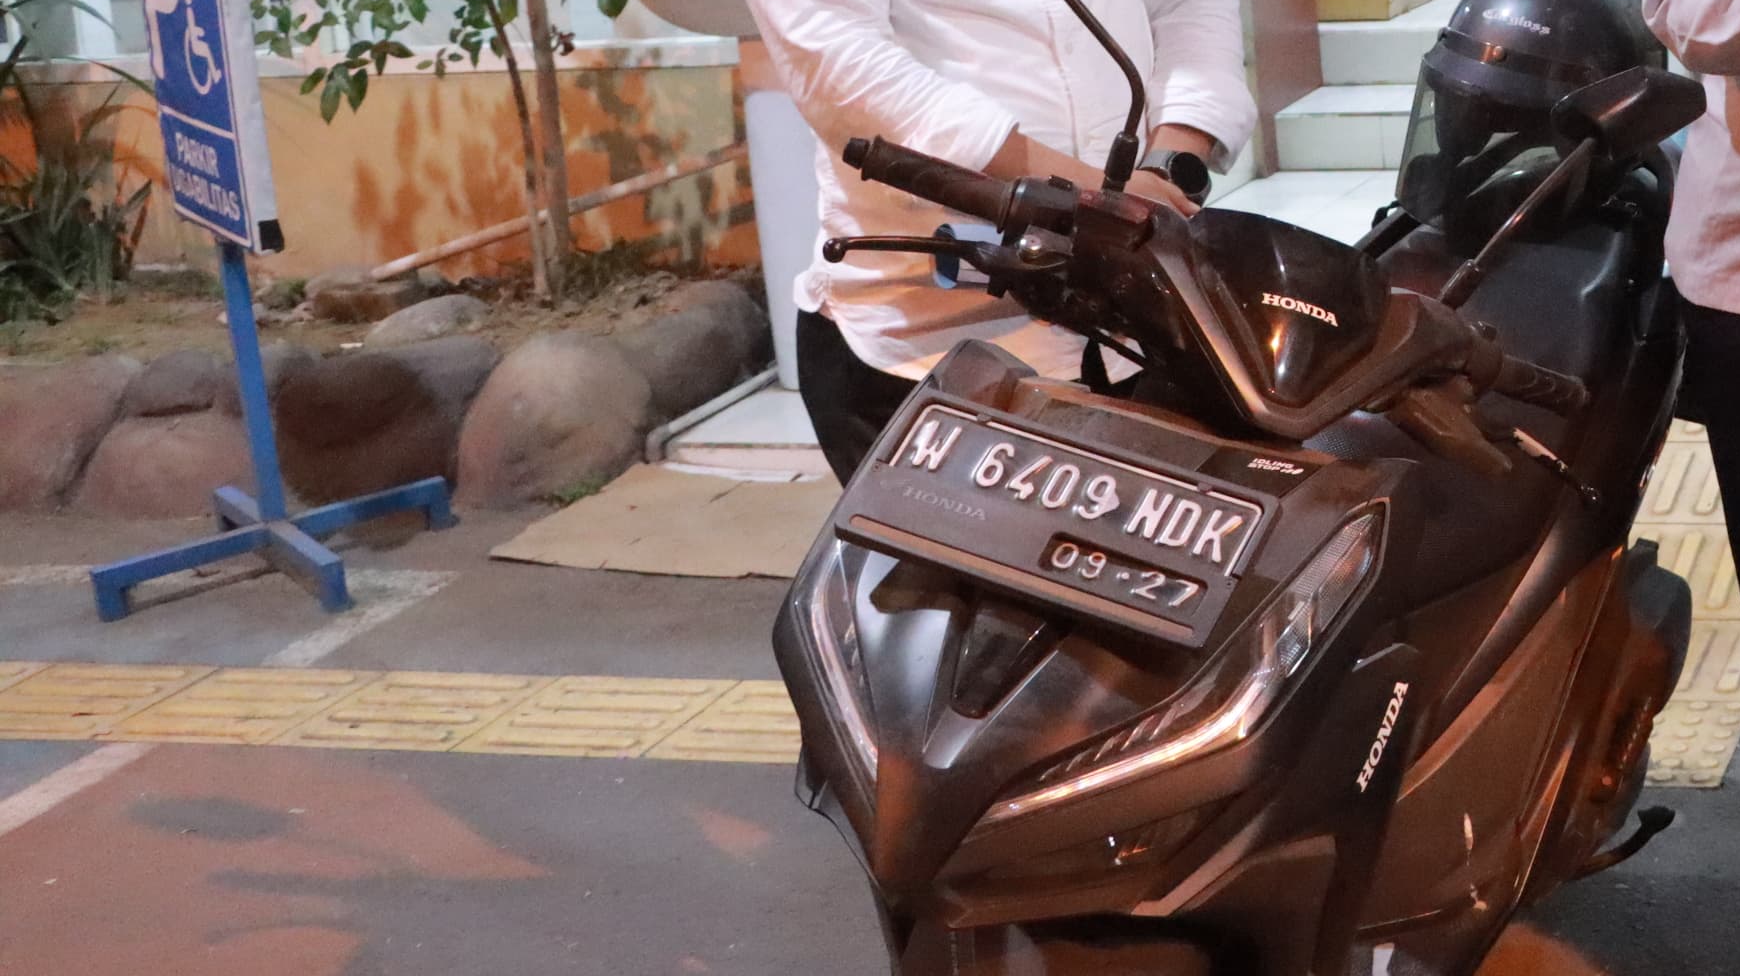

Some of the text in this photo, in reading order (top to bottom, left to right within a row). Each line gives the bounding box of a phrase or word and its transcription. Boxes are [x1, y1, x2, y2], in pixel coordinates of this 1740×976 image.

[175, 132, 220, 179] PARKIR
[170, 163, 241, 222] DISABILITAS
[1261, 293, 1339, 327] HONDA
[1247, 463, 1281, 471] STOP
[1252, 458, 1294, 468] IDLING
[903, 486, 986, 520] HONDA
[910, 419, 1244, 563] W 6409 NDK
[1356, 681, 1409, 793] HONDA
